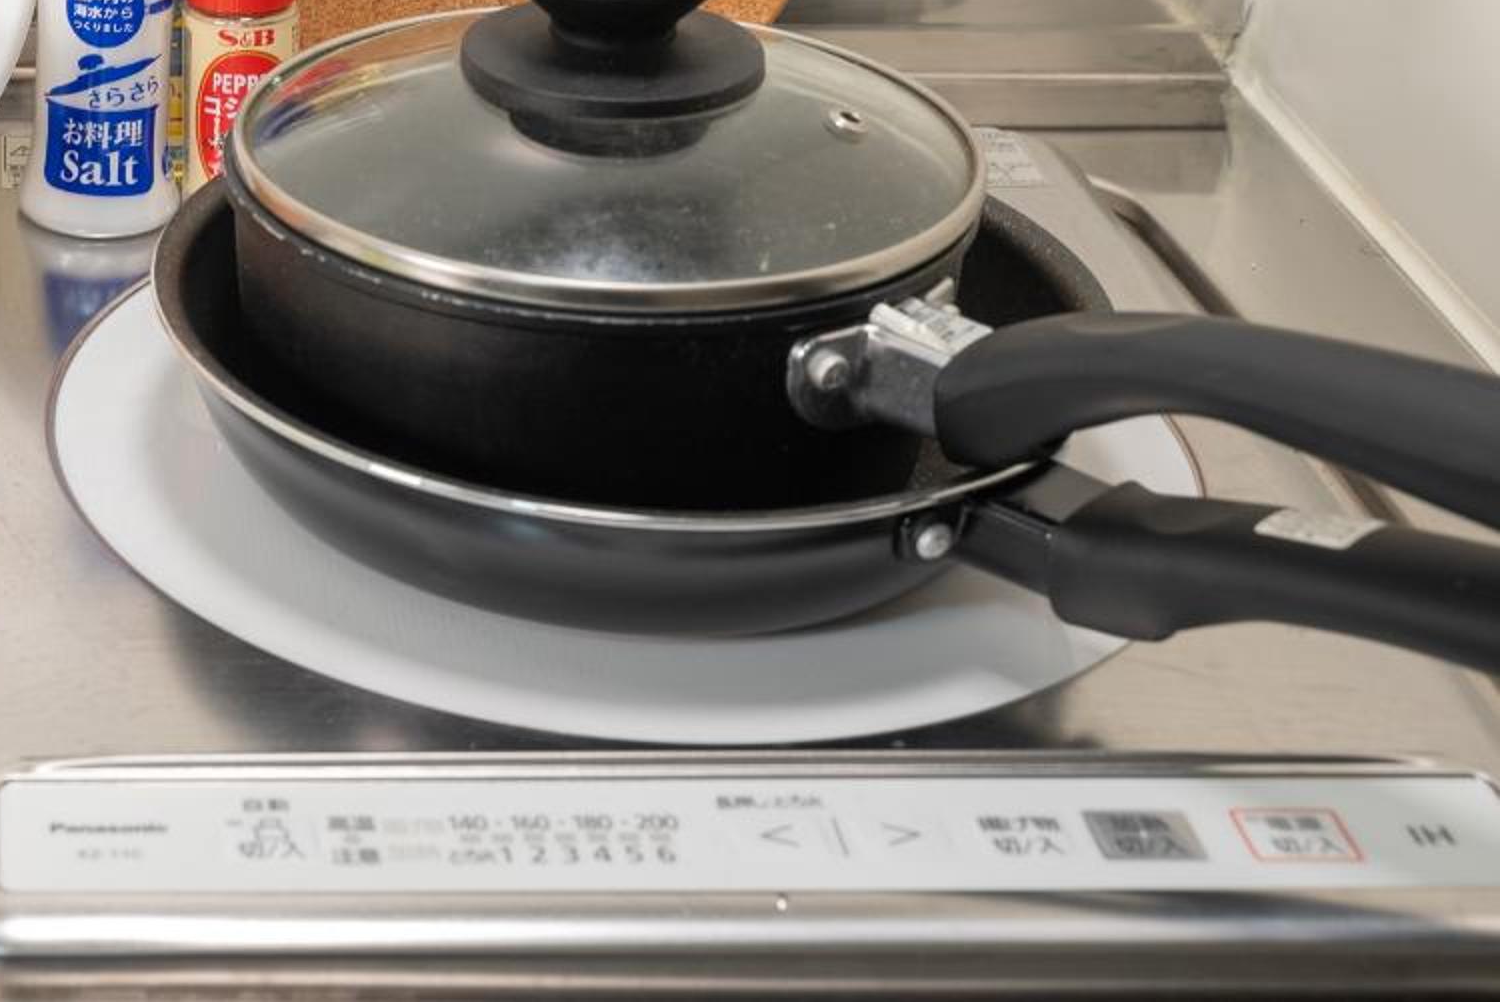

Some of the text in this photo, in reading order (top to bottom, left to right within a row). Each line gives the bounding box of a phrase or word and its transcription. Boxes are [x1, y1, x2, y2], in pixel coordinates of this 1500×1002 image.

[73, 21, 134, 33] つくりました
[212, 72, 265, 95] PEPP
[203, 95, 241, 119] コシ
[62, 117, 145, 150] お料理
[60, 149, 140, 187] Salt
[49, 821, 170, 834] Panasonic
